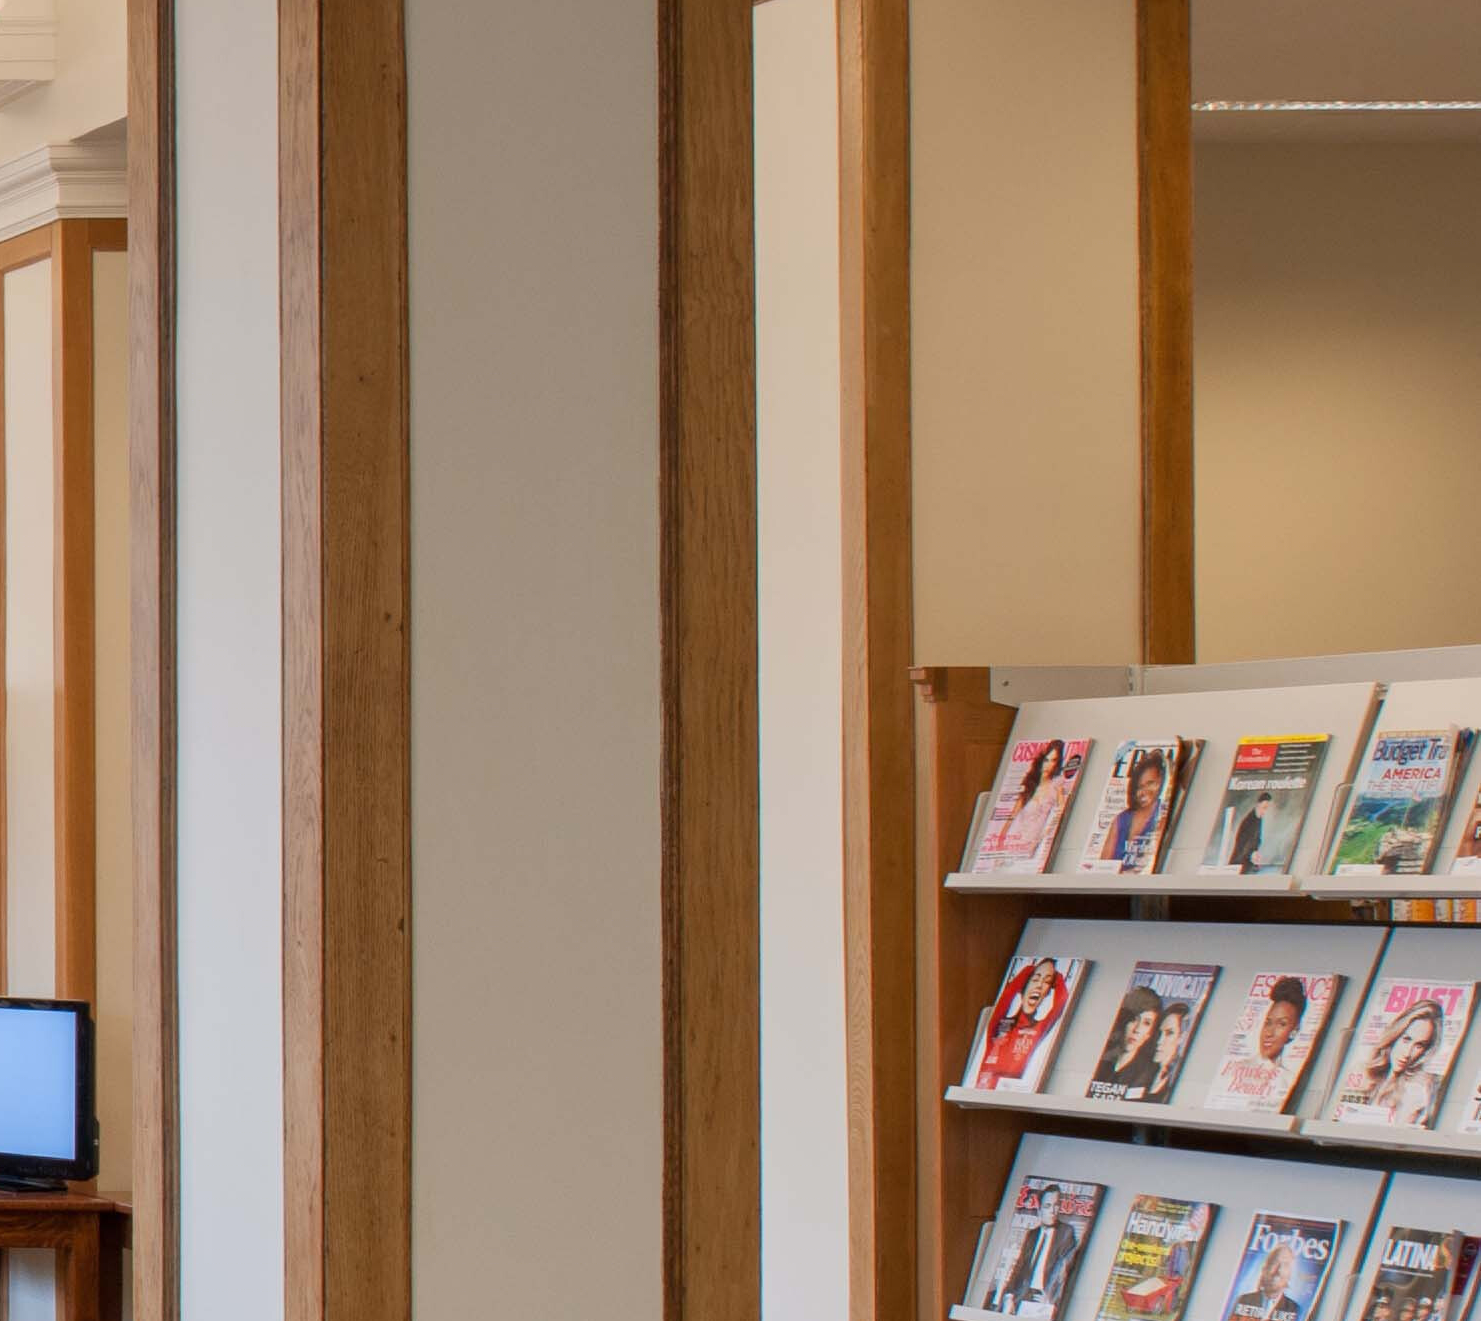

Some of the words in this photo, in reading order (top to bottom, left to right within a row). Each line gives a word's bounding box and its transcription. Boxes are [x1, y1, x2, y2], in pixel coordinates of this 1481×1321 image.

[1373, 738, 1427, 766] Budget
[1382, 767, 1441, 780] AMERICA
[1249, 1223, 1330, 1260] Forbes
